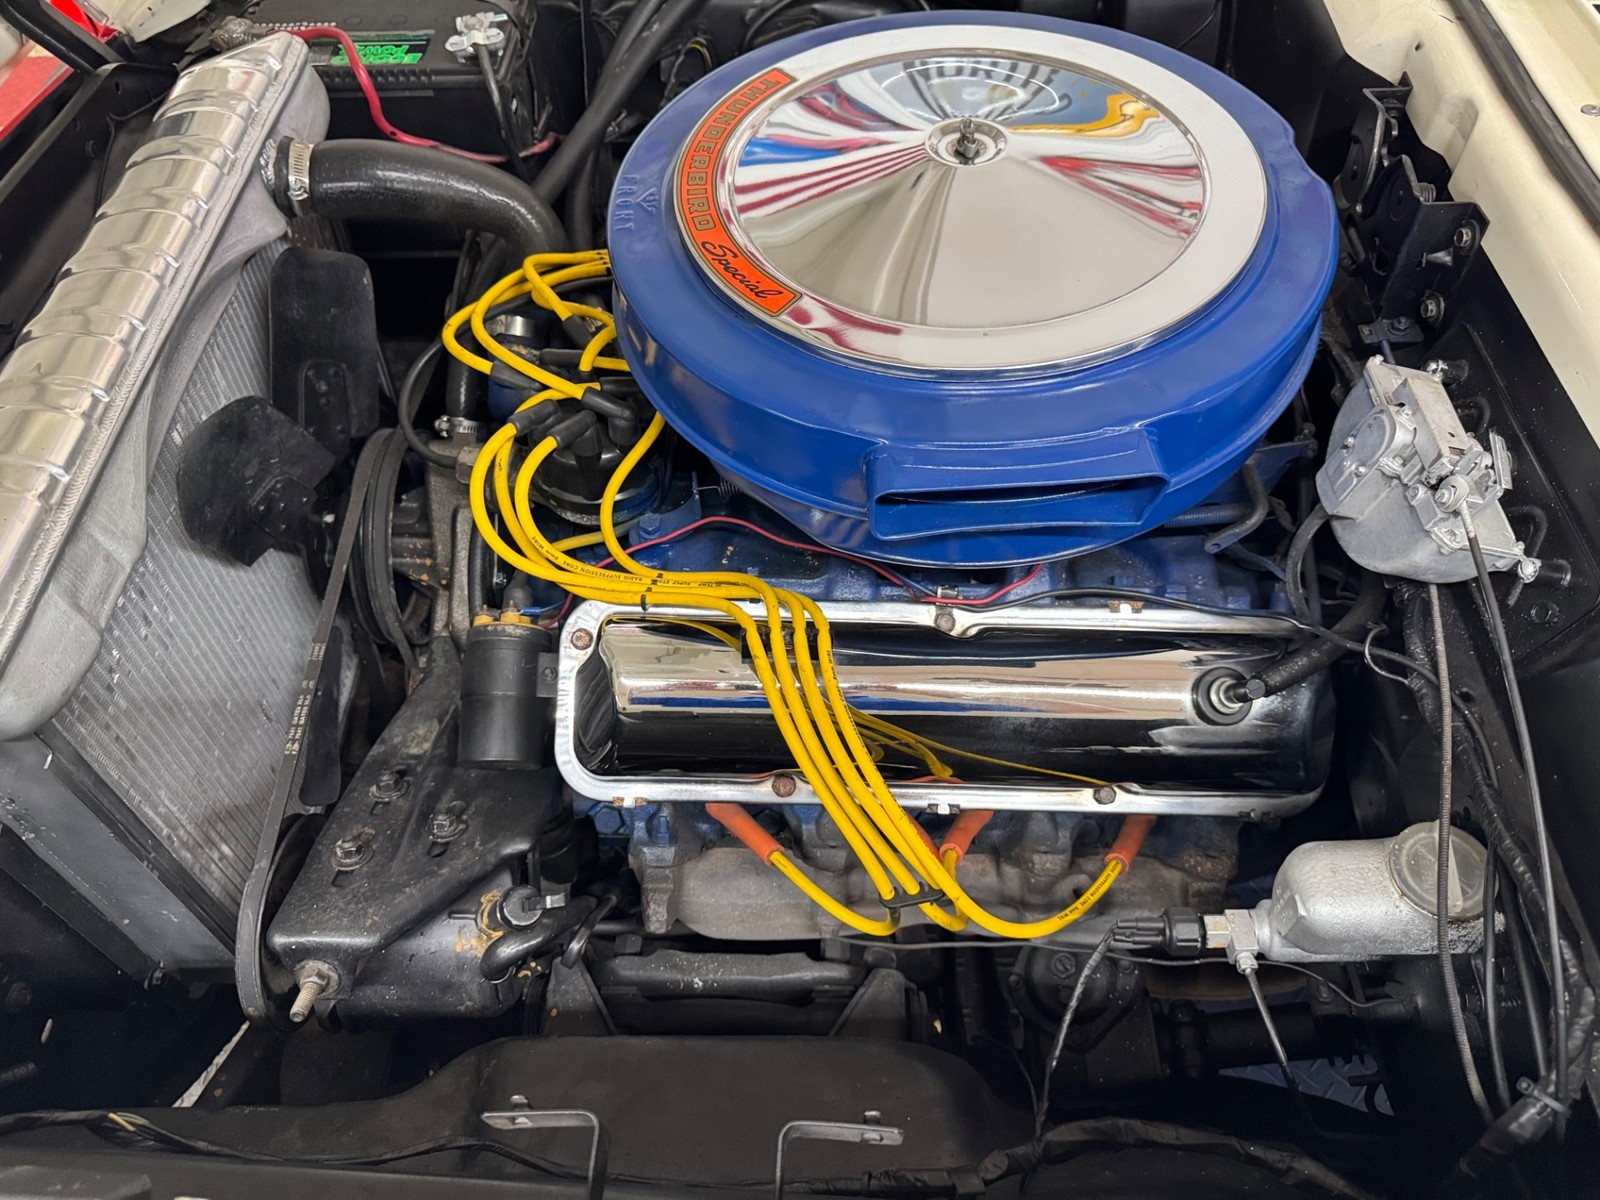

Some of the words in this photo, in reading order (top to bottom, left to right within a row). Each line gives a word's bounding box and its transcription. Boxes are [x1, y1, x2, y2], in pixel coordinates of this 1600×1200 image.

[686, 78, 781, 232] THUNDERBIRD
[701, 240, 784, 300] Special
[531, 536, 545, 550] WIRE
[562, 560, 580, 571] CORE
[580, 567, 622, 580] SUPPRESSION
